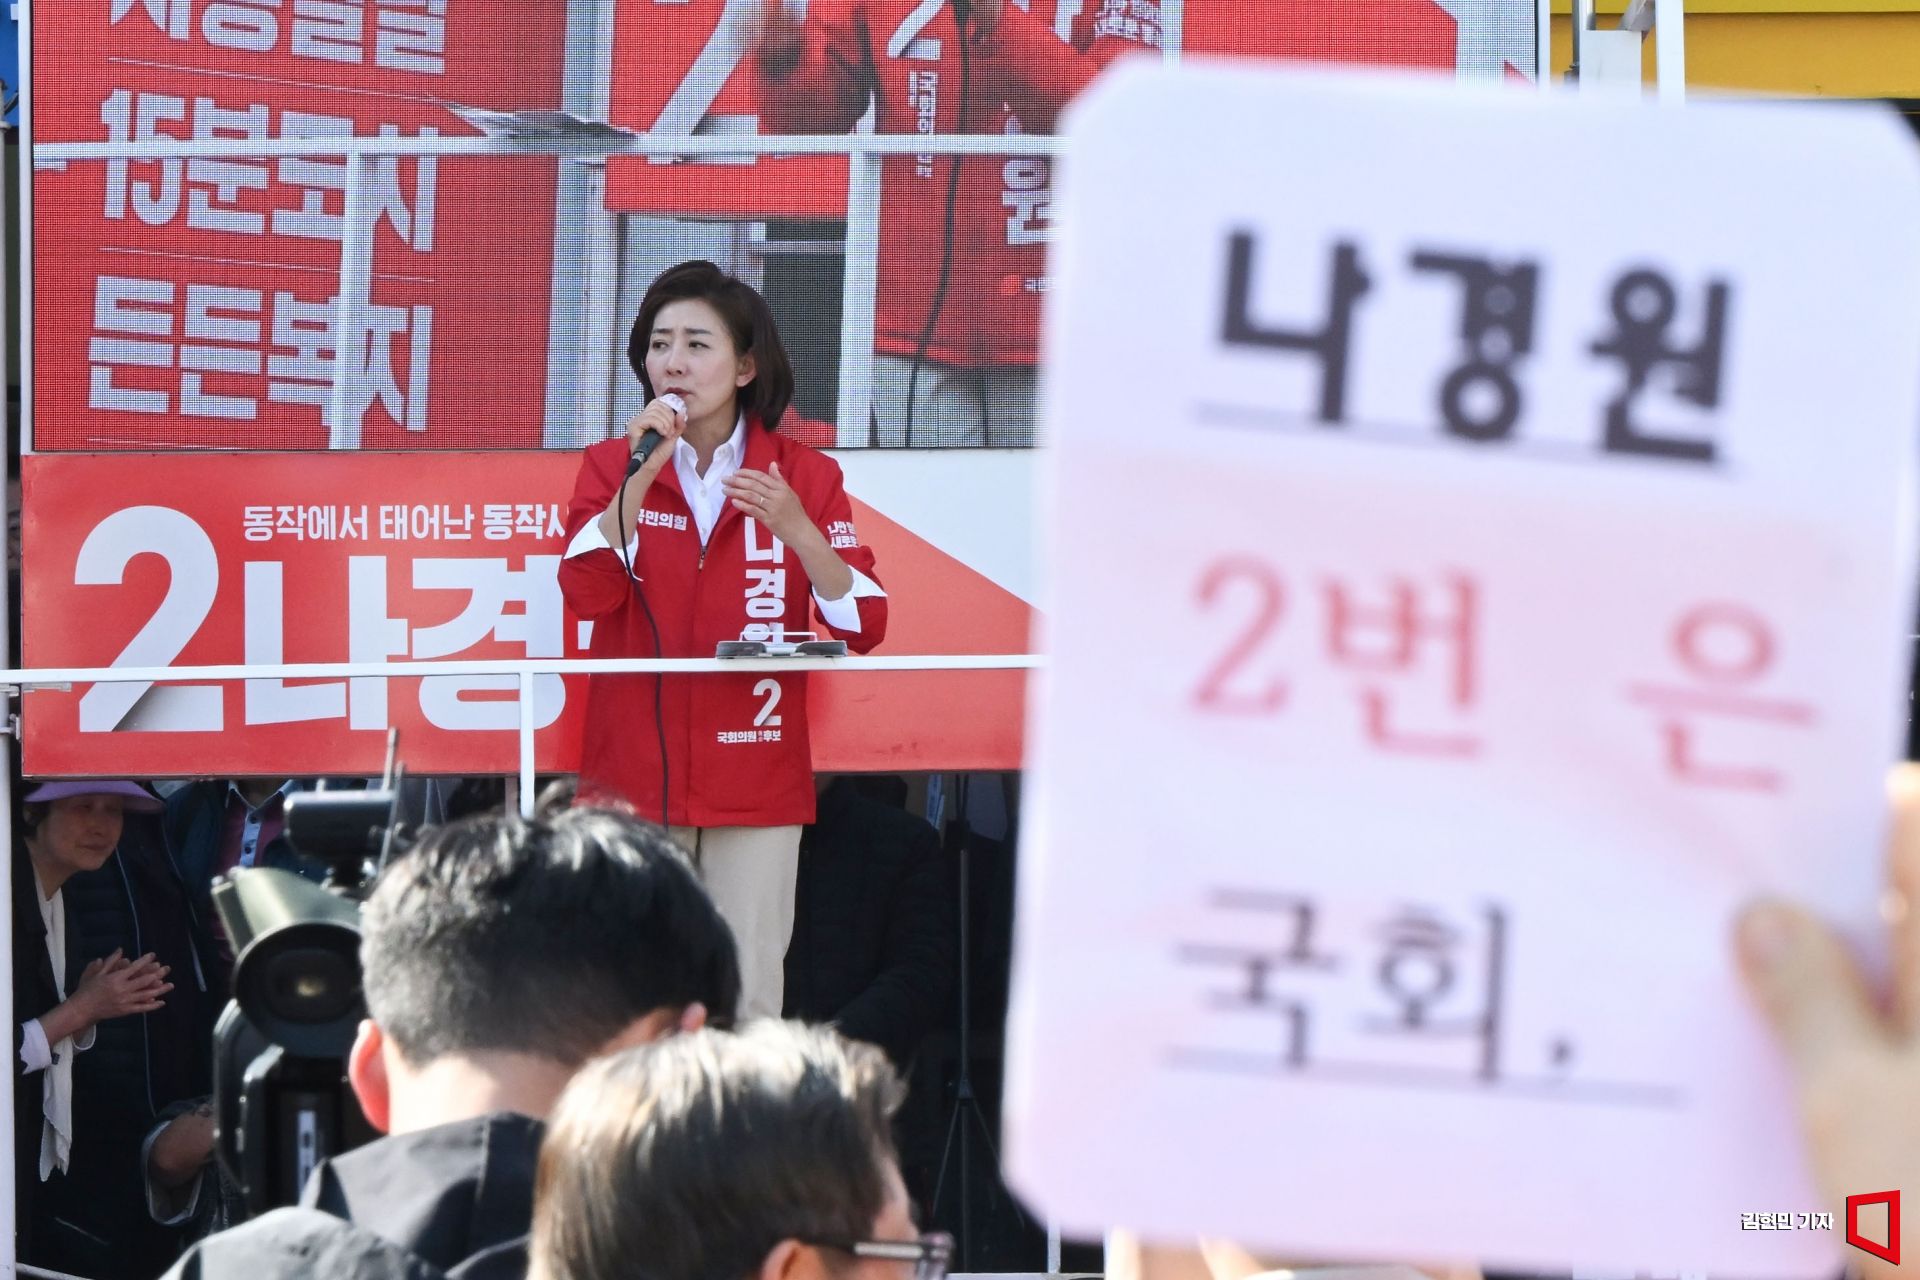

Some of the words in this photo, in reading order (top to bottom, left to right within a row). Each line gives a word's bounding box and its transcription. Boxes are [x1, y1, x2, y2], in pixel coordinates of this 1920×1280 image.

[1217, 228, 1735, 463] 나경원
[243, 505, 368, 542] 동작에서
[379, 504, 474, 541] 태어난
[74, 505, 224, 732] 2
[244, 554, 594, 731] 나경
[752, 678, 782, 727] 2
[1190, 554, 1484, 760] 2번
[1627, 600, 1819, 796] 은
[717, 731, 757, 744] 국회의원
[763, 729, 782, 742] 후보
